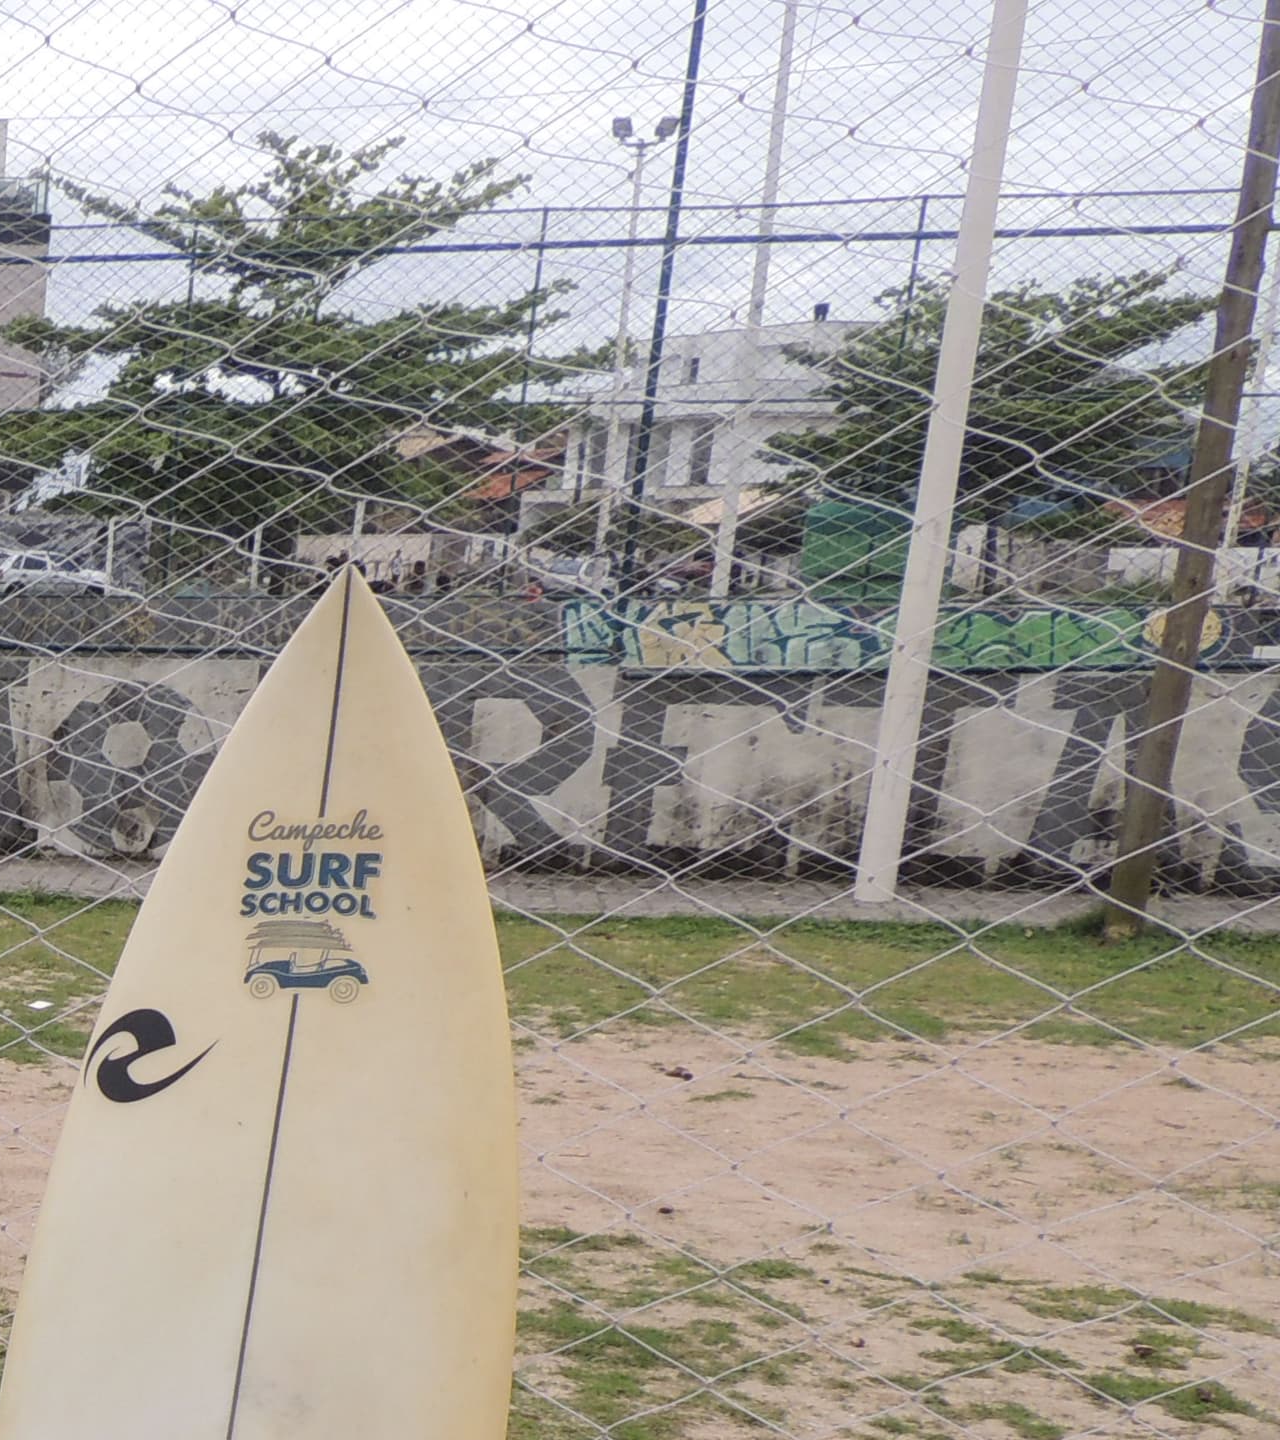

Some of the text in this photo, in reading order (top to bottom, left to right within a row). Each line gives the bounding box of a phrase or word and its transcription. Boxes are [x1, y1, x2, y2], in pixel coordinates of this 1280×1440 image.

[247, 809, 385, 851] Campeche
[244, 851, 385, 891] SURF
[240, 890, 378, 920] SCHOOL
